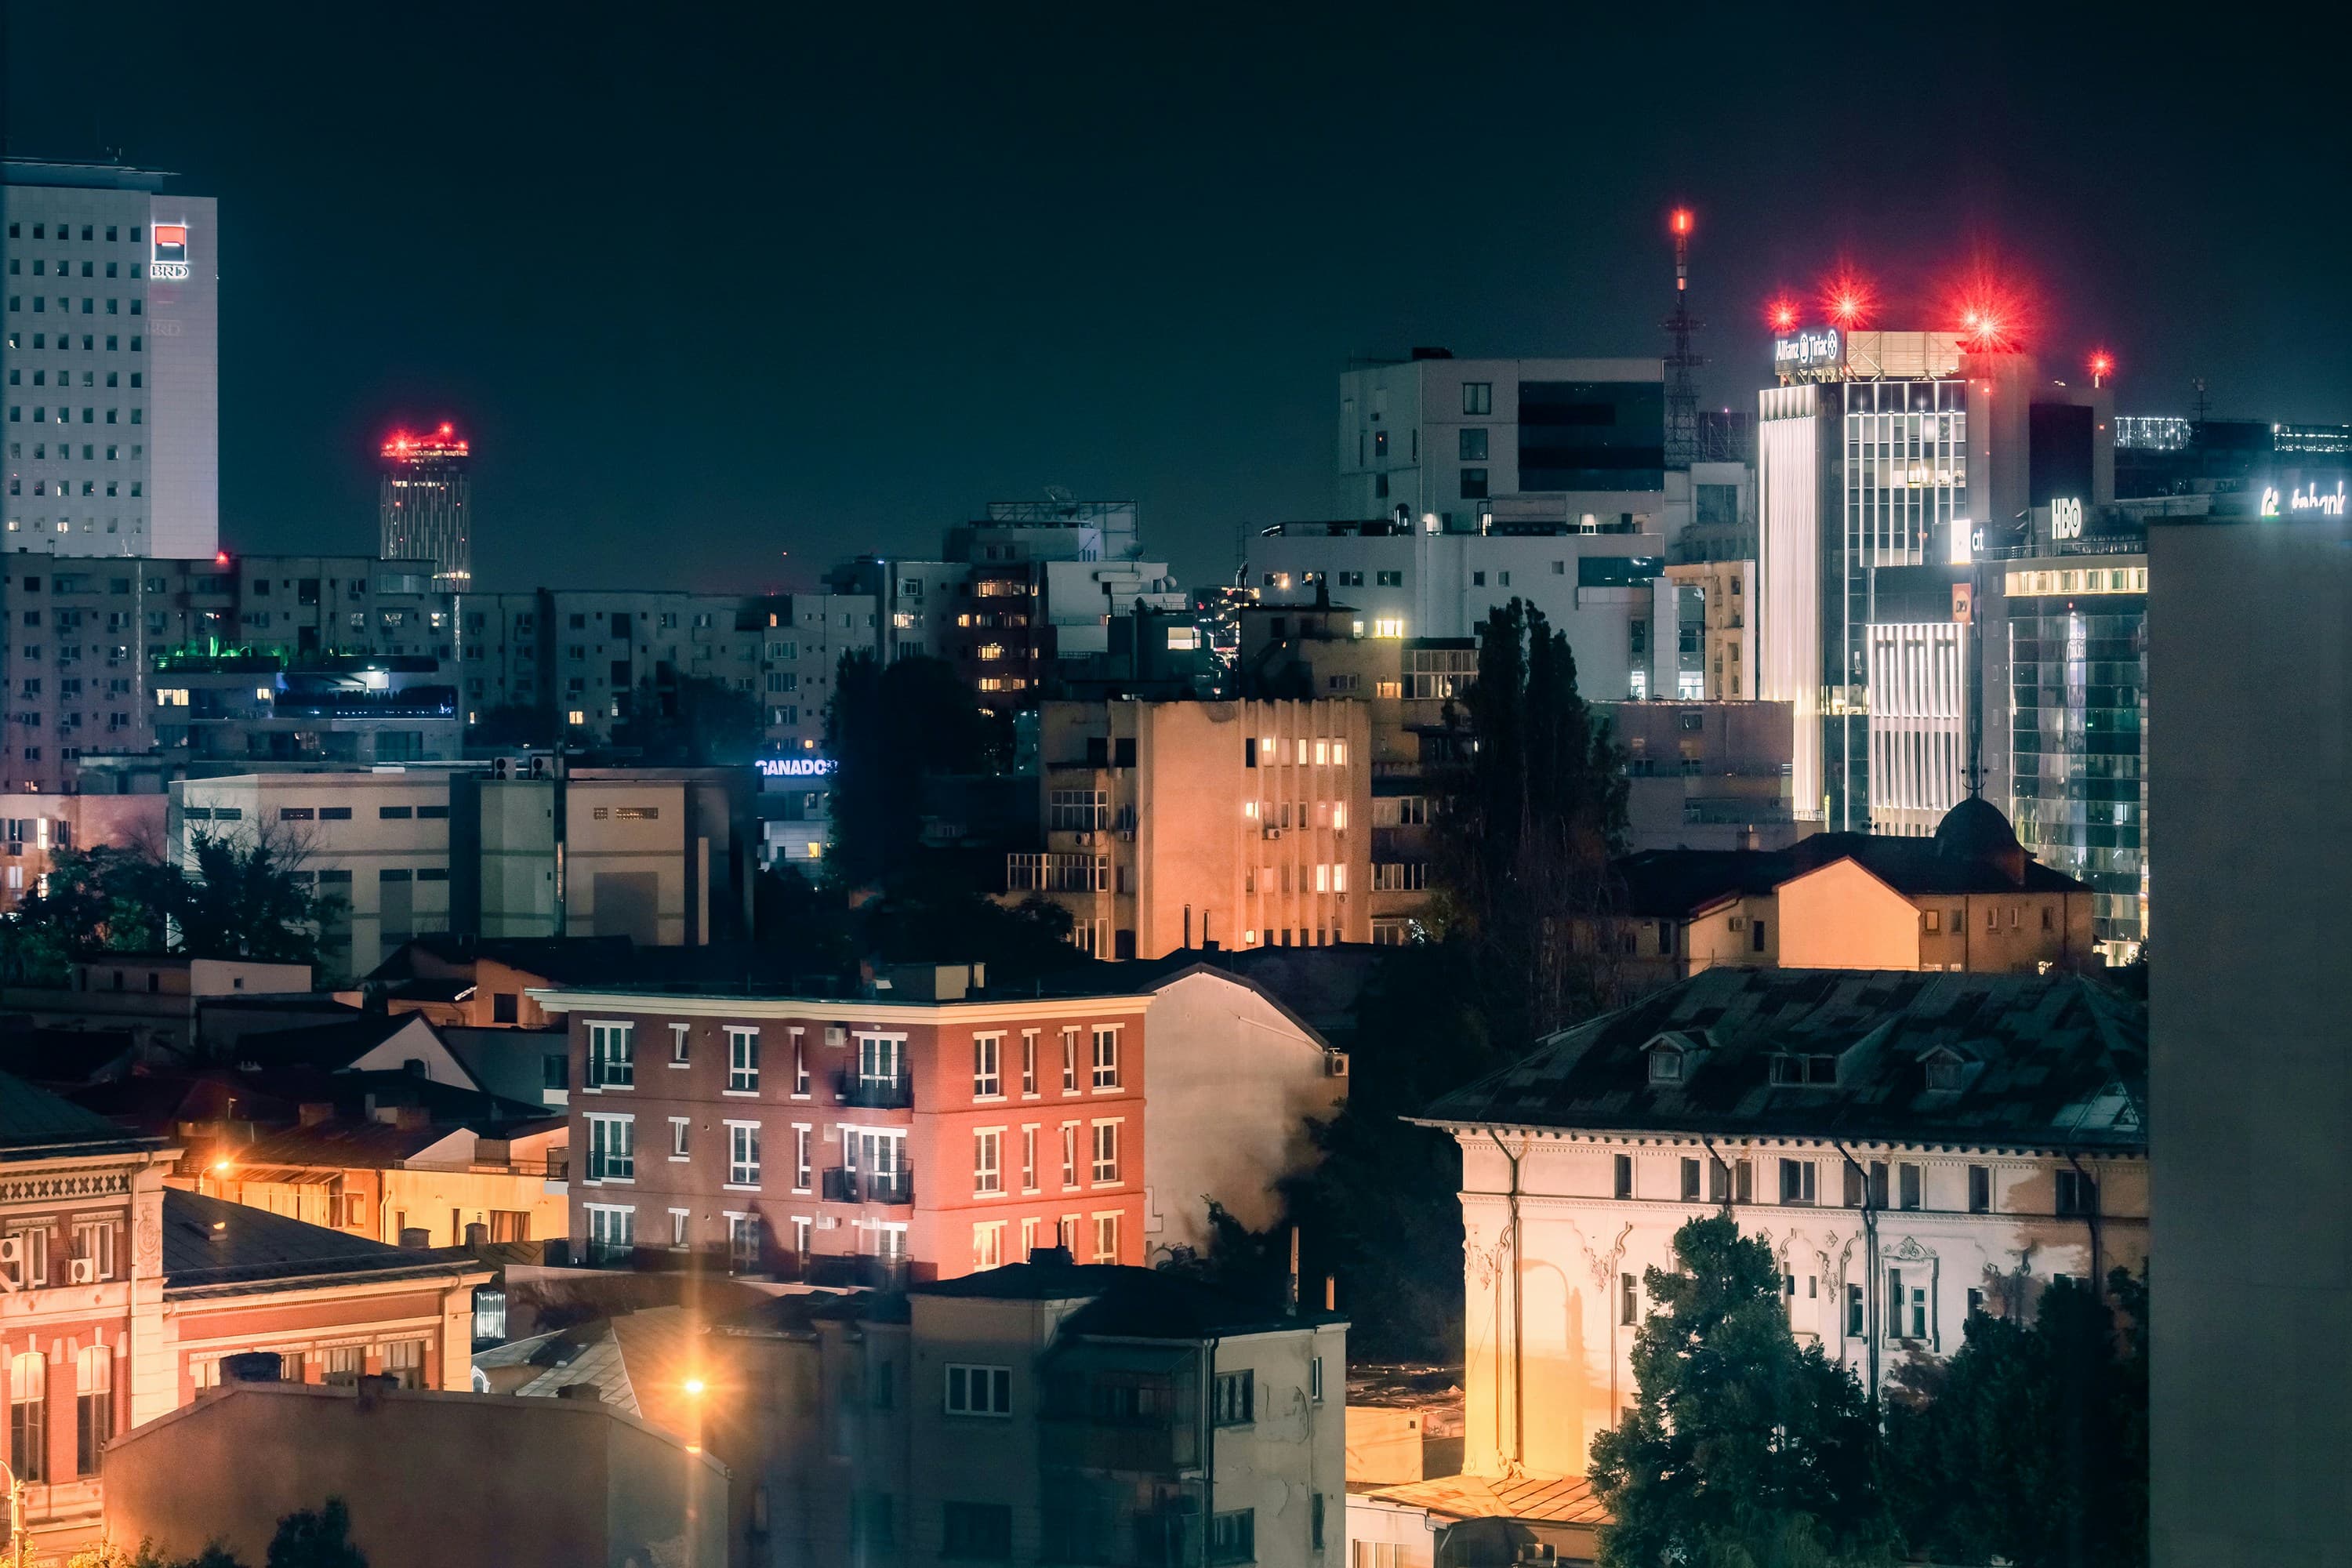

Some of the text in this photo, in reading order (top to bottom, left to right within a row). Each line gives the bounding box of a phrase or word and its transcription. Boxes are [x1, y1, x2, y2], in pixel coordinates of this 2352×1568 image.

[151, 265, 188, 278] BRD
[1777, 339, 1799, 361] Allianz
[2052, 497, 2082, 540] HBO
